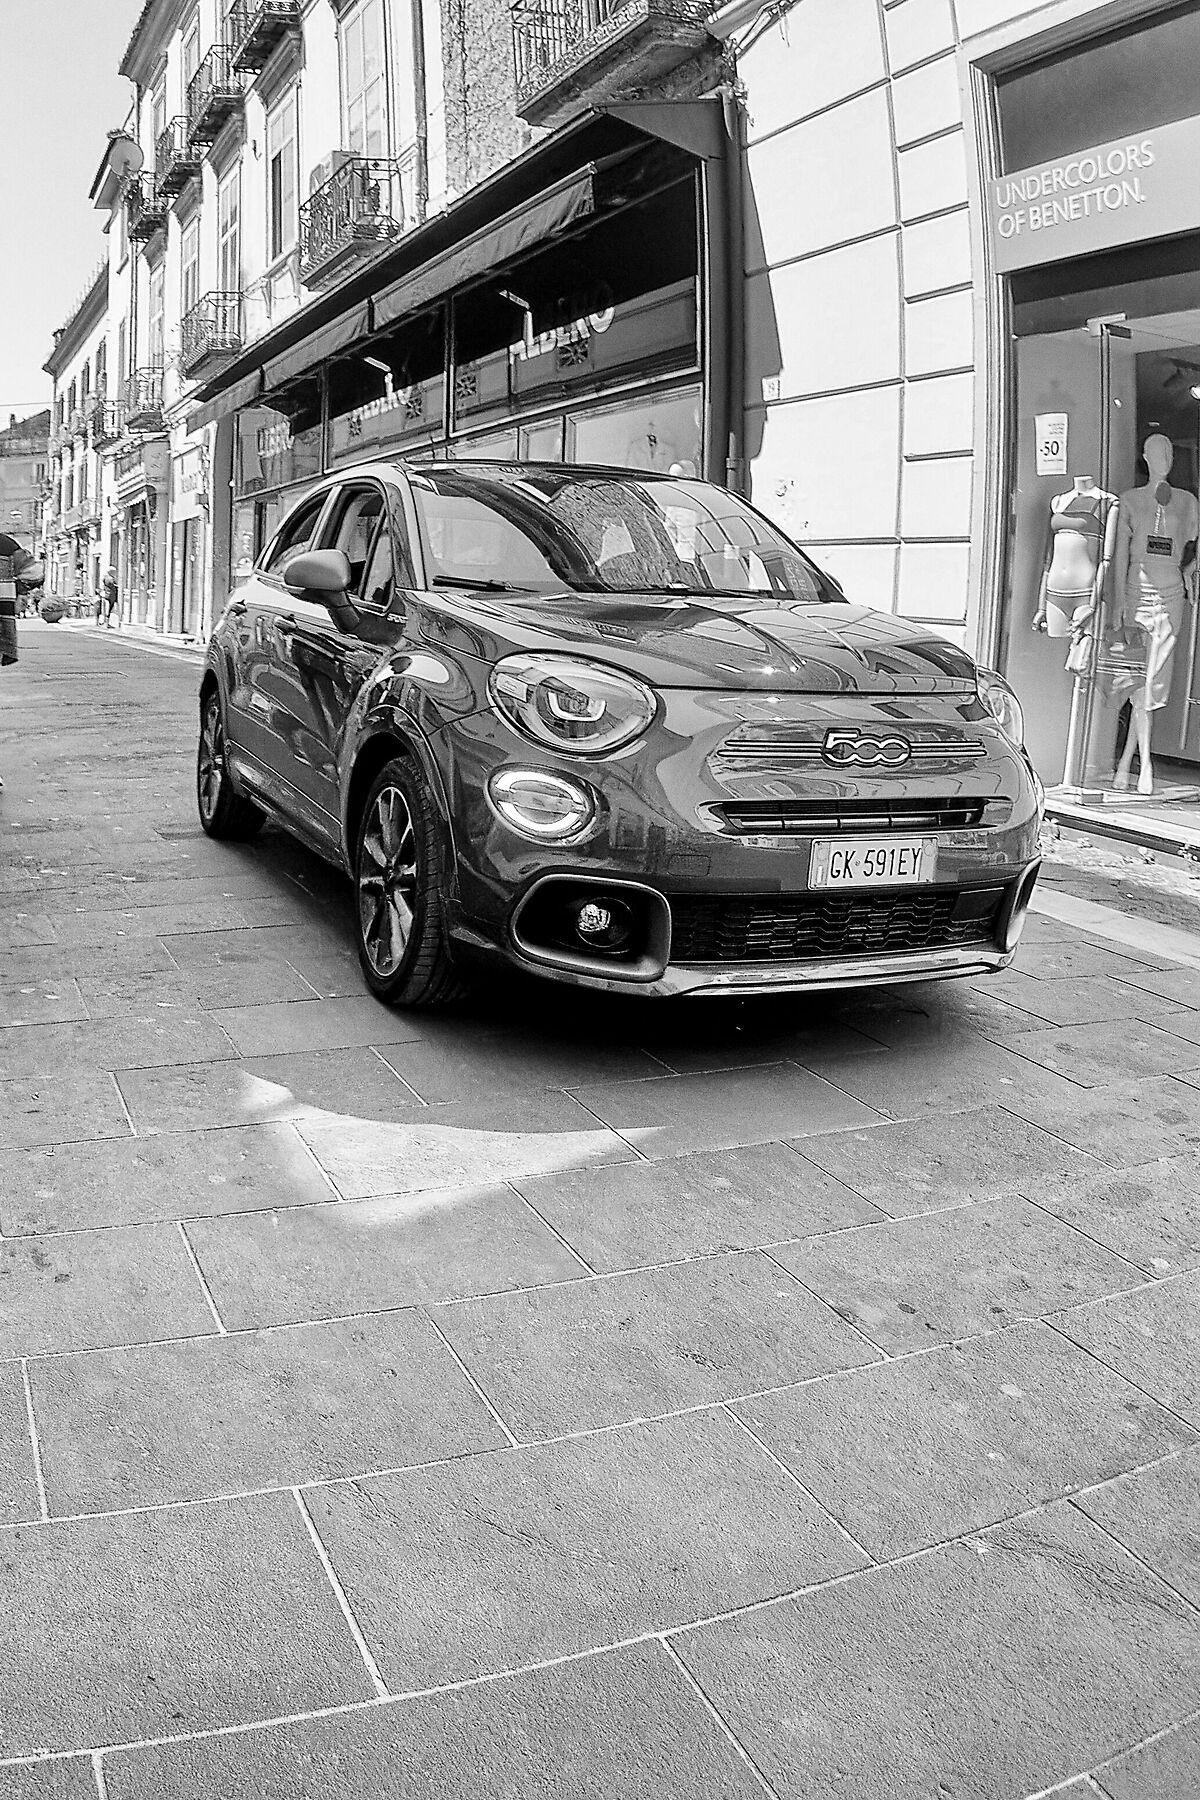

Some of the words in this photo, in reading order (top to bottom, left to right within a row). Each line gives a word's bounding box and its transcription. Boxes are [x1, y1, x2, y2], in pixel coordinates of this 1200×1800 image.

[996, 140, 1154, 207] UNDERCOLORS
[999, 209, 1026, 238] OF
[823, 728, 910, 767] 500
[830, 850, 856, 879] GK
[863, 847, 922, 877] 591EY
